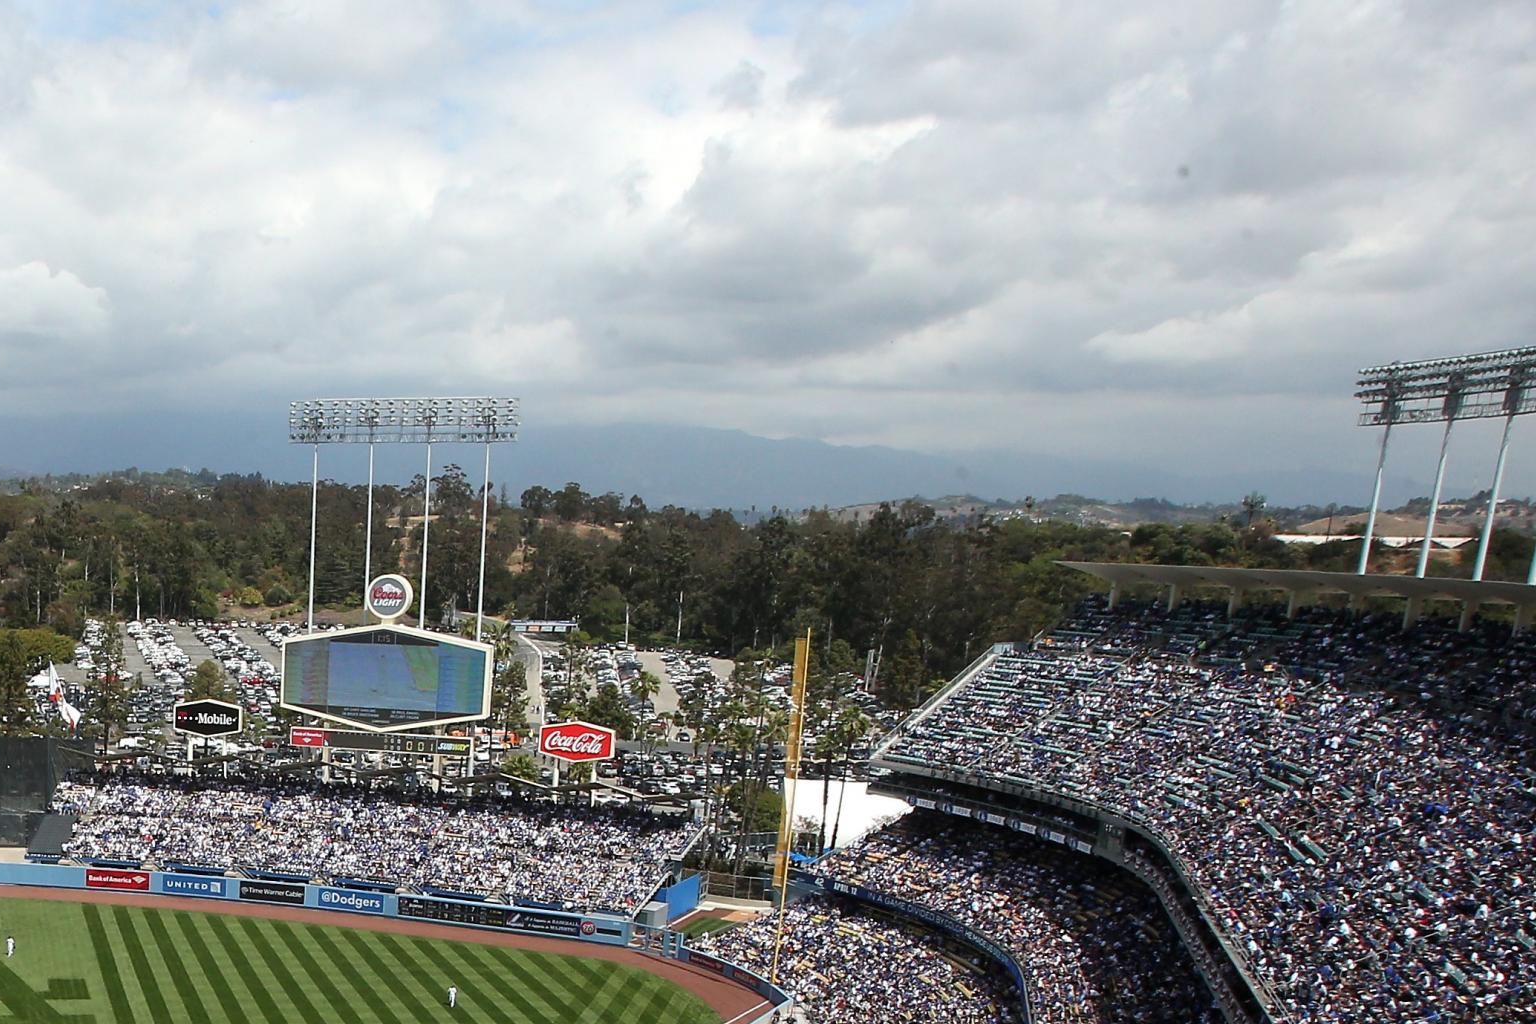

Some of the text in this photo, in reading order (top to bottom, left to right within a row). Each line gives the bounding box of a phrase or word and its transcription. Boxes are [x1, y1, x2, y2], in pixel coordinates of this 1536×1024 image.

[373, 587, 404, 600] Coors
[438, 742, 470, 751] SUBWAY
[544, 730, 606, 754] Coca-Cola
[166, 880, 208, 890] UNITED
[833, 882, 849, 894] APRIL
[264, 889, 285, 897] Warner
[285, 890, 304, 898] Cable
[322, 892, 381, 910] @Dodgers
[884, 896, 906, 910] GAME
[907, 902, 935, 921] DIVIDED
